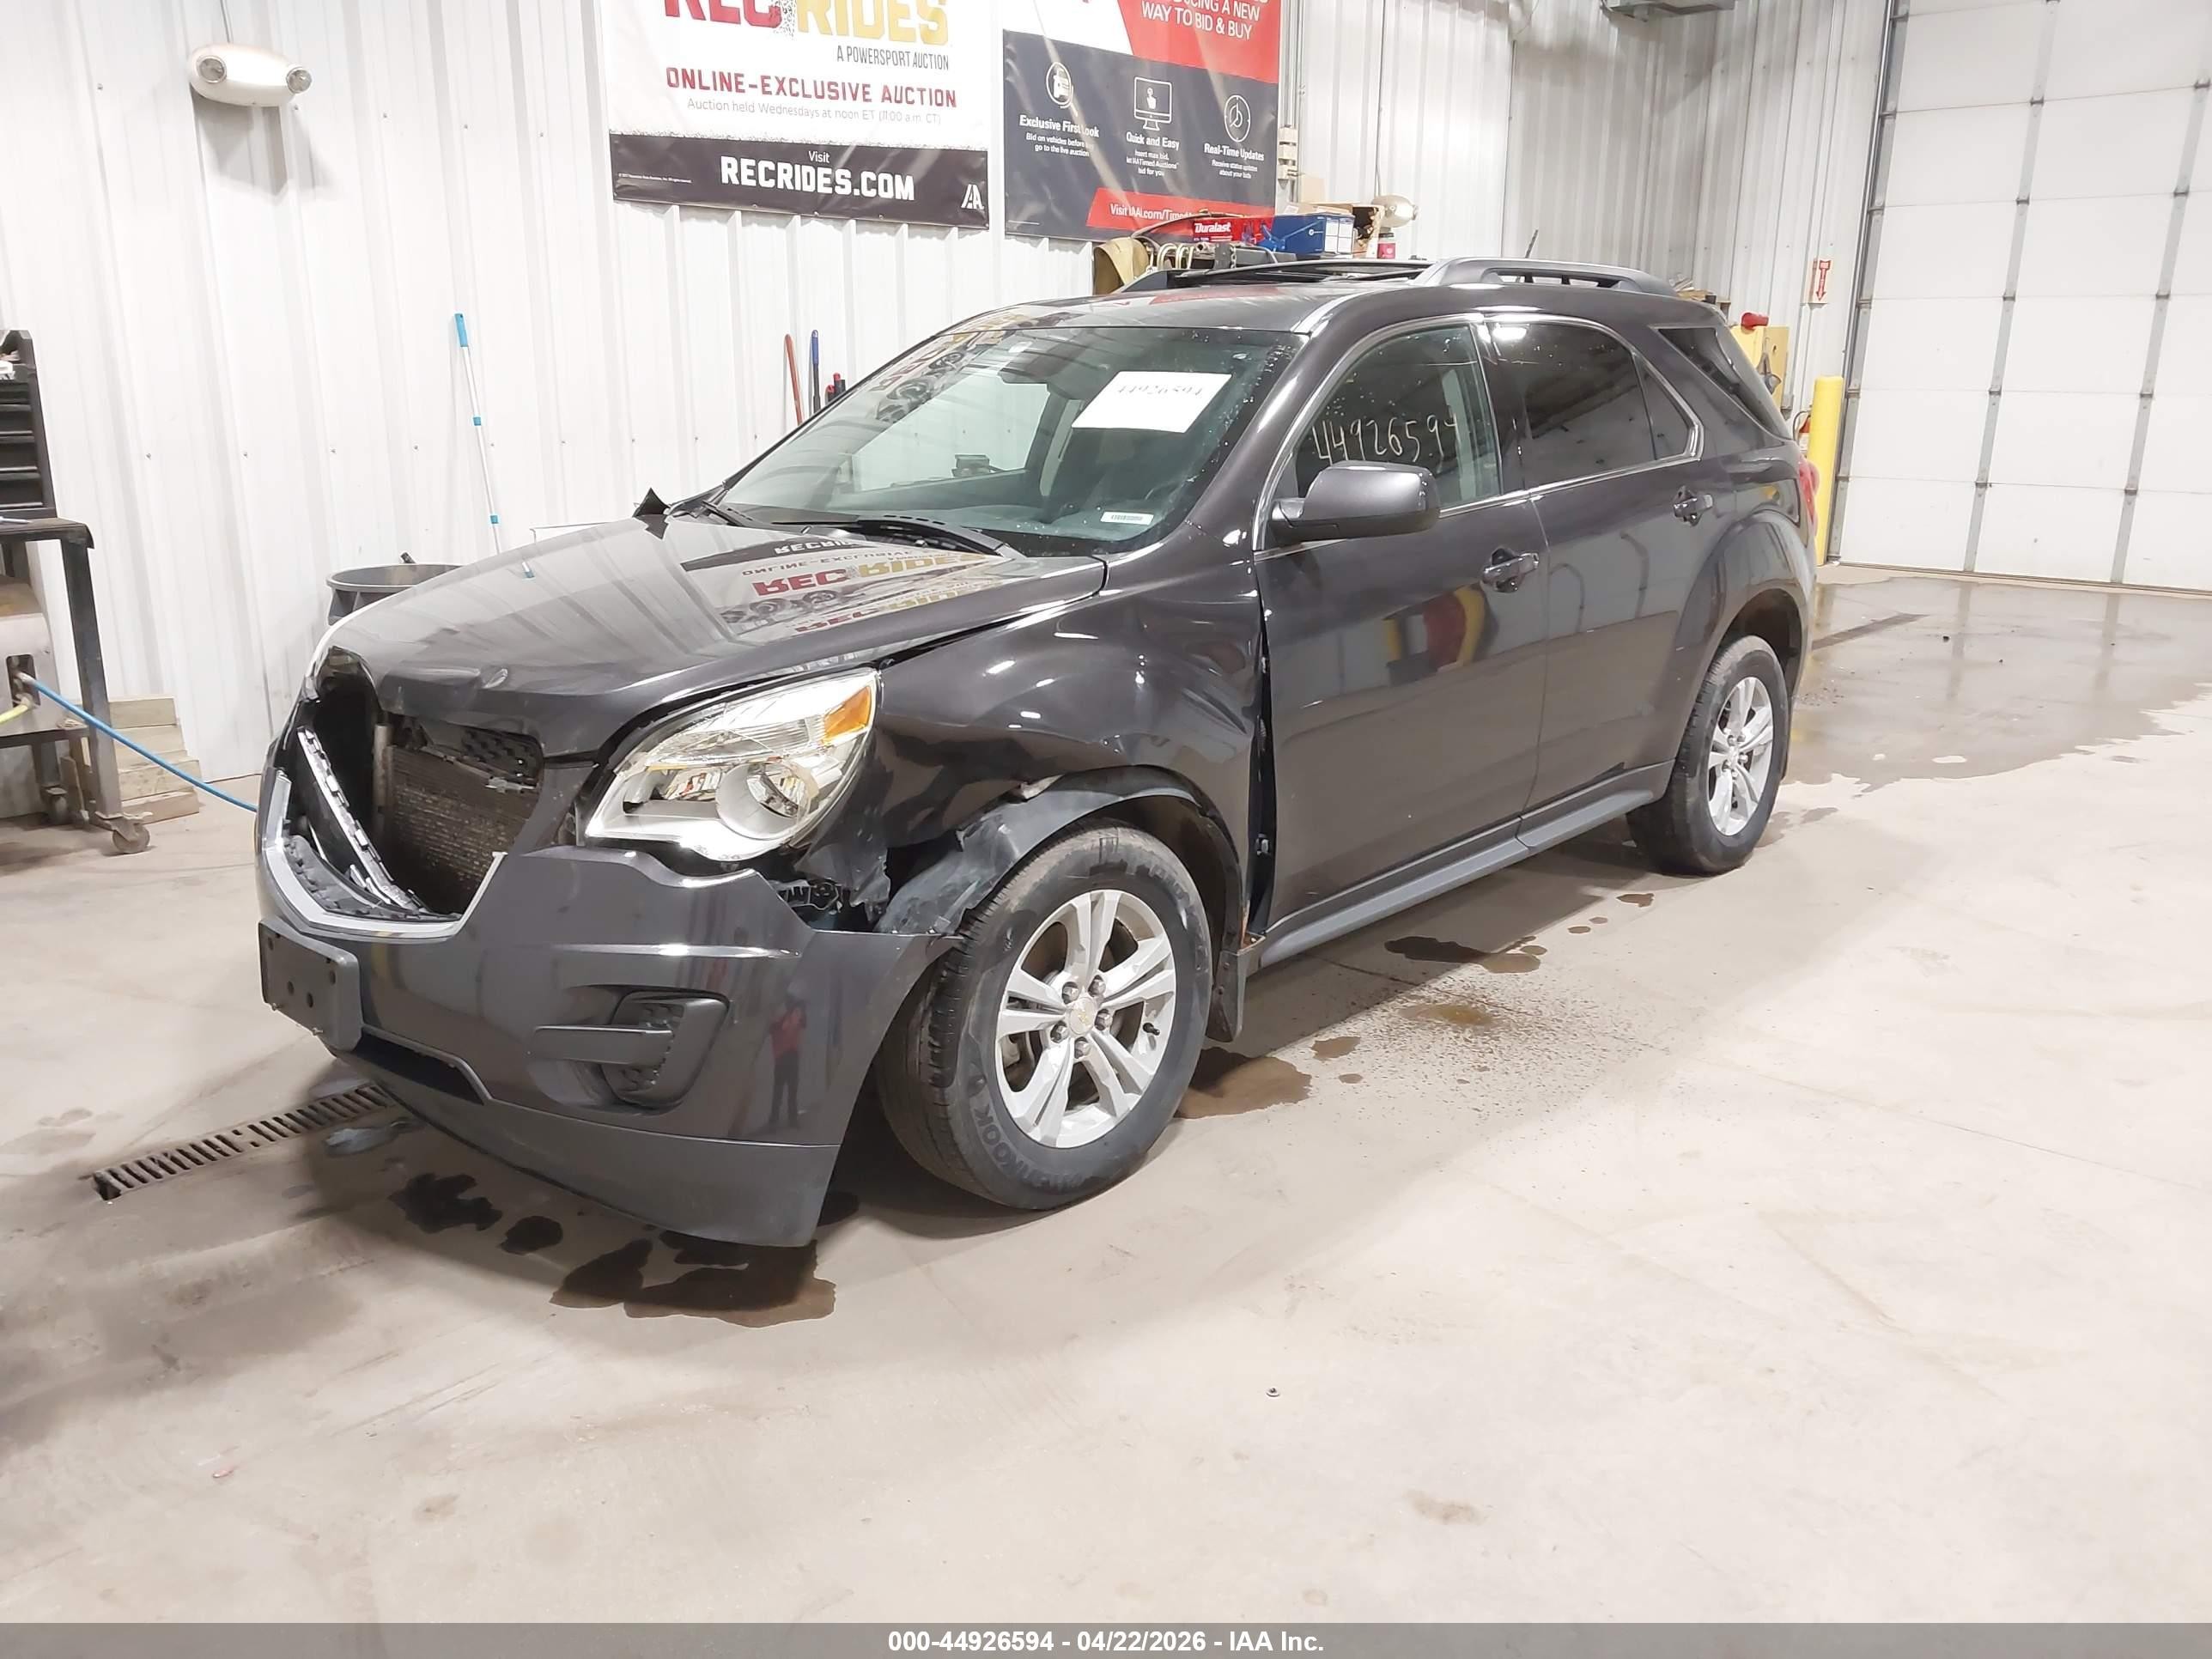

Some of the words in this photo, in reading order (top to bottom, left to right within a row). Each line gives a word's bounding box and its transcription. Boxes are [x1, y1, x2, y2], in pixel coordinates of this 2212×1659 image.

[1141, 2, 1172, 22] WAY
[1174, 7, 1193, 26] TO
[1194, 13, 1213, 32] BID
[1216, 17, 1225, 35] &
[1227, 21, 1253, 40] BUY
[1222, 0, 1231, 15] A
[1233, 3, 1261, 21] NEW
[836, 45, 844, 62] A
[847, 46, 911, 68] POWERSPORT
[912, 52, 949, 71] AUCTION
[665, 67, 872, 103] ONLINE-EXCLUSIVE
[881, 84, 957, 108] AUCTION
[687, 98, 730, 112] Auction
[732, 99, 756, 113] held
[758, 101, 820, 119] Wednesdays
[822, 108, 832, 118] at
[835, 110, 860, 120] noon
[862, 109, 875, 121] ET
[1019, 114, 1061, 131] Exclusive
[1062, 120, 1081, 133] First
[1126, 131, 1145, 145] Quick
[1146, 135, 1160, 146] and
[1162, 137, 1180, 151] Easy
[808, 150, 830, 164] Visit
[1204, 143, 1239, 157] Real-Time
[1240, 147, 1265, 162] Updates
[720, 155, 915, 201] RECRIDES.COM
[1110, 204, 1127, 216] Visit
[1194, 222, 1231, 234] Duralast
[1311, 412, 1462, 473] 44926594
